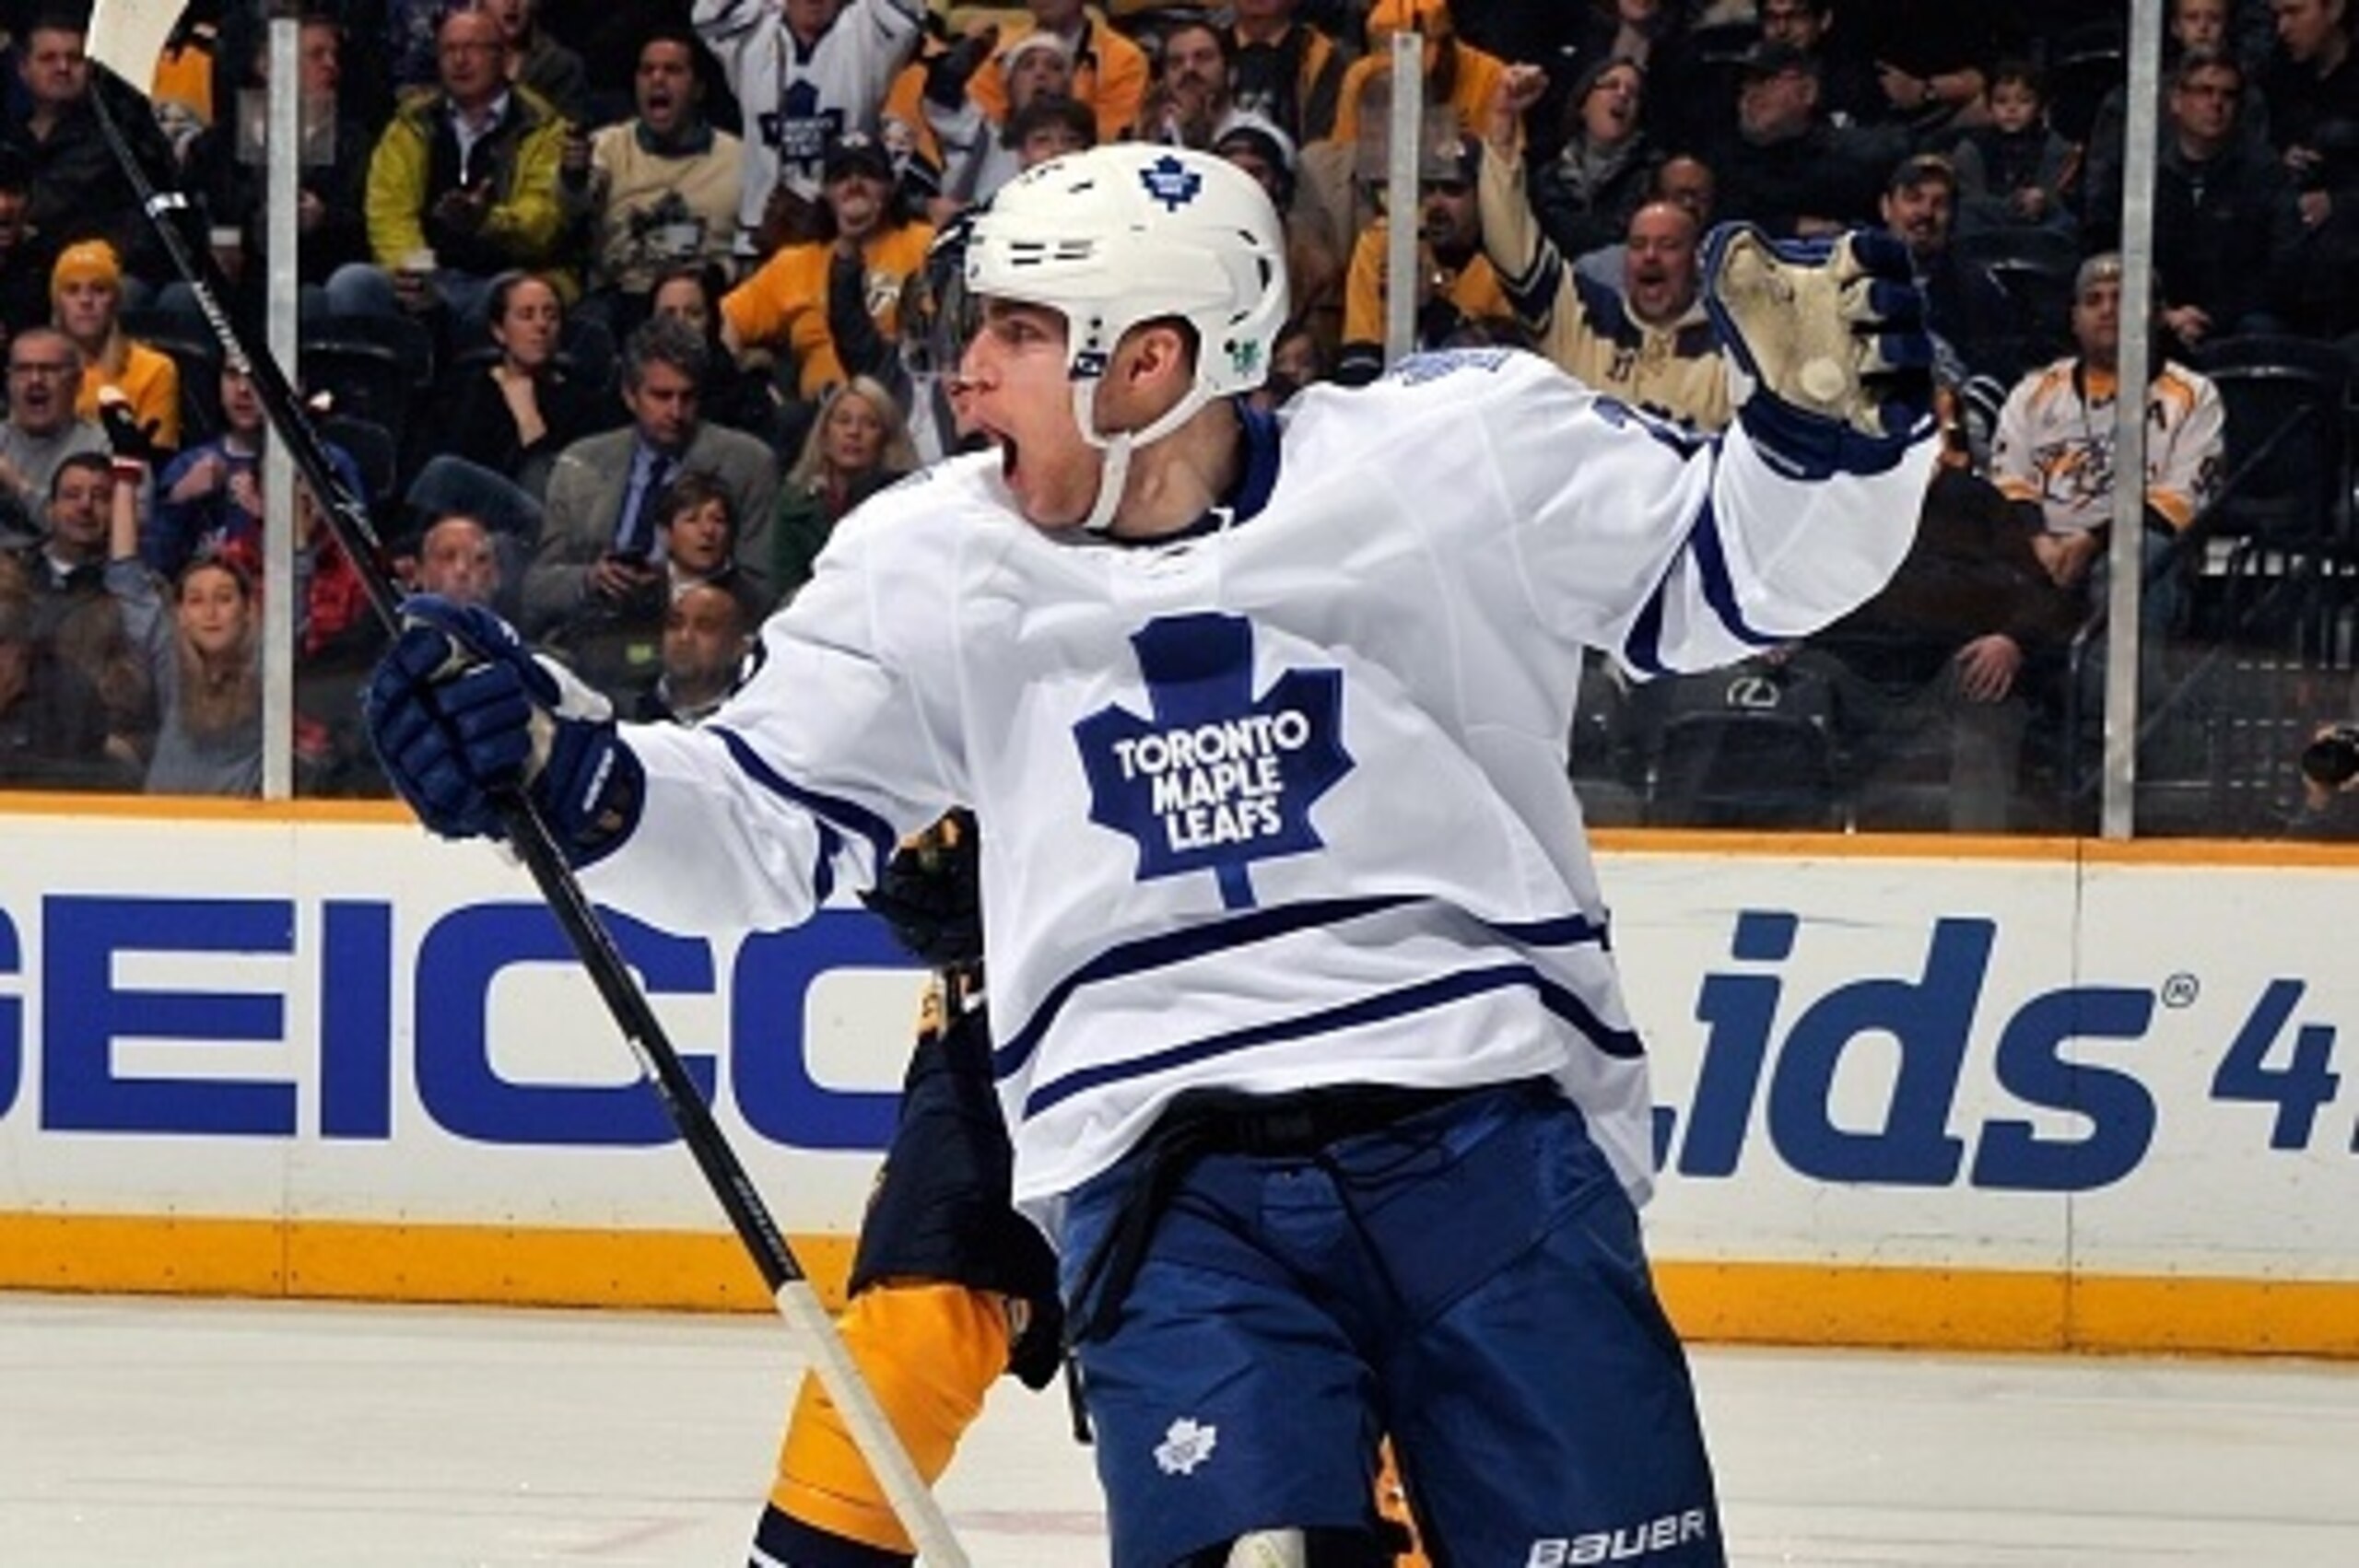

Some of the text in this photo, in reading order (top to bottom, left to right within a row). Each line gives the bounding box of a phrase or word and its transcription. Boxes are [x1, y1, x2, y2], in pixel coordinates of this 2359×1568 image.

[1113, 709, 1309, 780] TORONTO
[1153, 755, 1283, 815] MAPLE
[1167, 796, 1282, 852] LEAFS
[0, 894, 924, 1148] EICO
[1652, 909, 2157, 1192] ids
[2210, 978, 2359, 1153] 4
